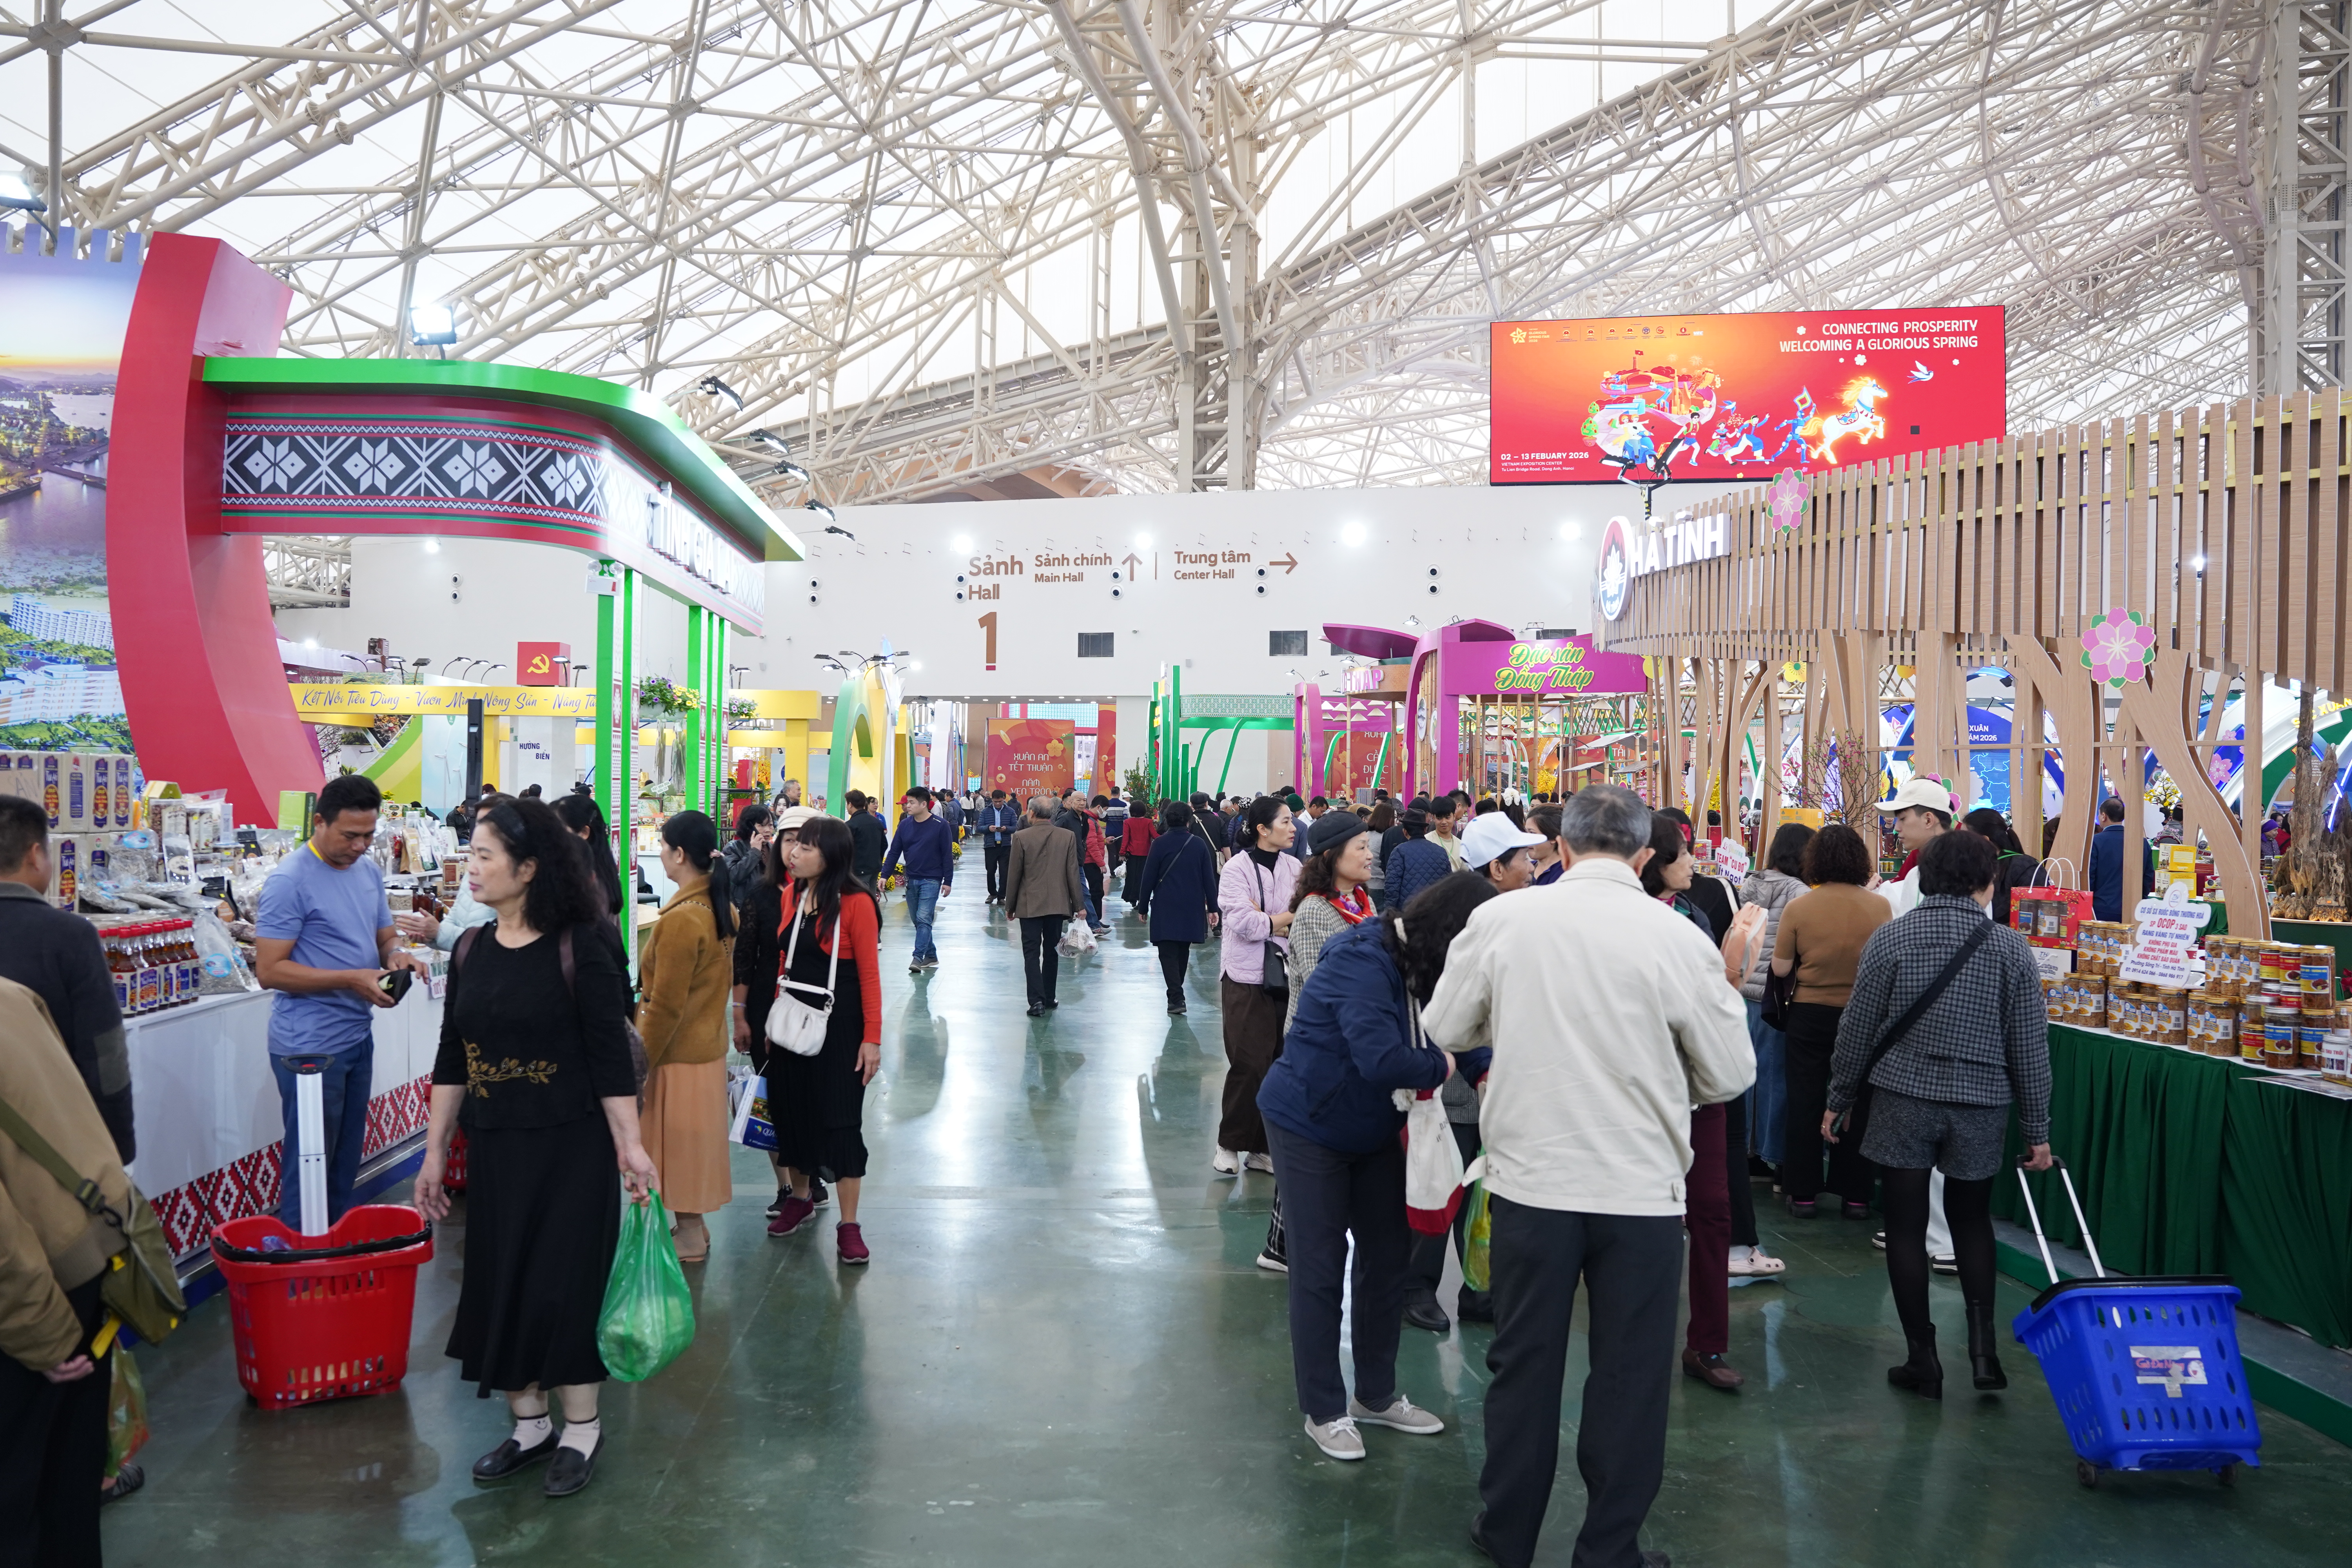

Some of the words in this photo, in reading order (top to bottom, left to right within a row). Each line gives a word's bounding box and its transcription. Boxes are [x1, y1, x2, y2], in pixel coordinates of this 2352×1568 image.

[1822, 322, 1898, 335] CONNECTING
[1904, 319, 1978, 333] PROSPERITY
[1780, 339, 1852, 352] WELCOMING
[1856, 339, 1865, 350] A
[1868, 337, 1929, 350] GLORIOUS
[1933, 336, 1978, 348] SPRING
[1630, 516, 1663, 577] HÀ
[1664, 510, 1726, 567] TĨNH
[969, 554, 1024, 576] Sảnh
[1034, 552, 1070, 568] Sảnh
[1073, 552, 1112, 566] chính
[1174, 550, 1218, 568] Trung
[1221, 550, 1250, 564] tâm
[1034, 573, 1060, 583] Main
[1062, 572, 1083, 582] Hall
[1174, 570, 1210, 581] Center
[1212, 569, 1234, 579] Hall
[968, 584, 1000, 600] Hall
[978, 611, 997, 664] 1
[1509, 642, 1551, 668] Đặc
[1552, 641, 1586, 664] sản
[1494, 664, 1549, 692] Đồng
[1548, 665, 1594, 691] Tháp
[302, 689, 322, 706] Kết
[324, 688, 344, 706] Nối
[345, 689, 367, 705] Tiêu
[369, 689, 400, 710] Dùng
[414, 691, 441, 706] Vươn
[484, 691, 510, 711] Nông
[514, 691, 538, 709] Sản
[553, 692, 581, 713] Nâng
[585, 693, 597, 709] Tầ
[1969, 724, 1989, 732] XUÂN
[519, 740, 540, 750] HƯỚNG
[536, 750, 550, 760] BIỂN
[1014, 752, 1035, 760] XUÂN
[1008, 761, 1024, 771] TẾT
[1027, 762, 1053, 773] THUẬN
[1363, 764, 1389, 774] ĐƯC
[1011, 788, 1027, 797] VẸN
[1029, 786, 1051, 795] TRÒN
[1717, 852, 1728, 866] TEAM
[2157, 918, 2176, 929] OCOP
[762, 1128, 778, 1137] QUA
